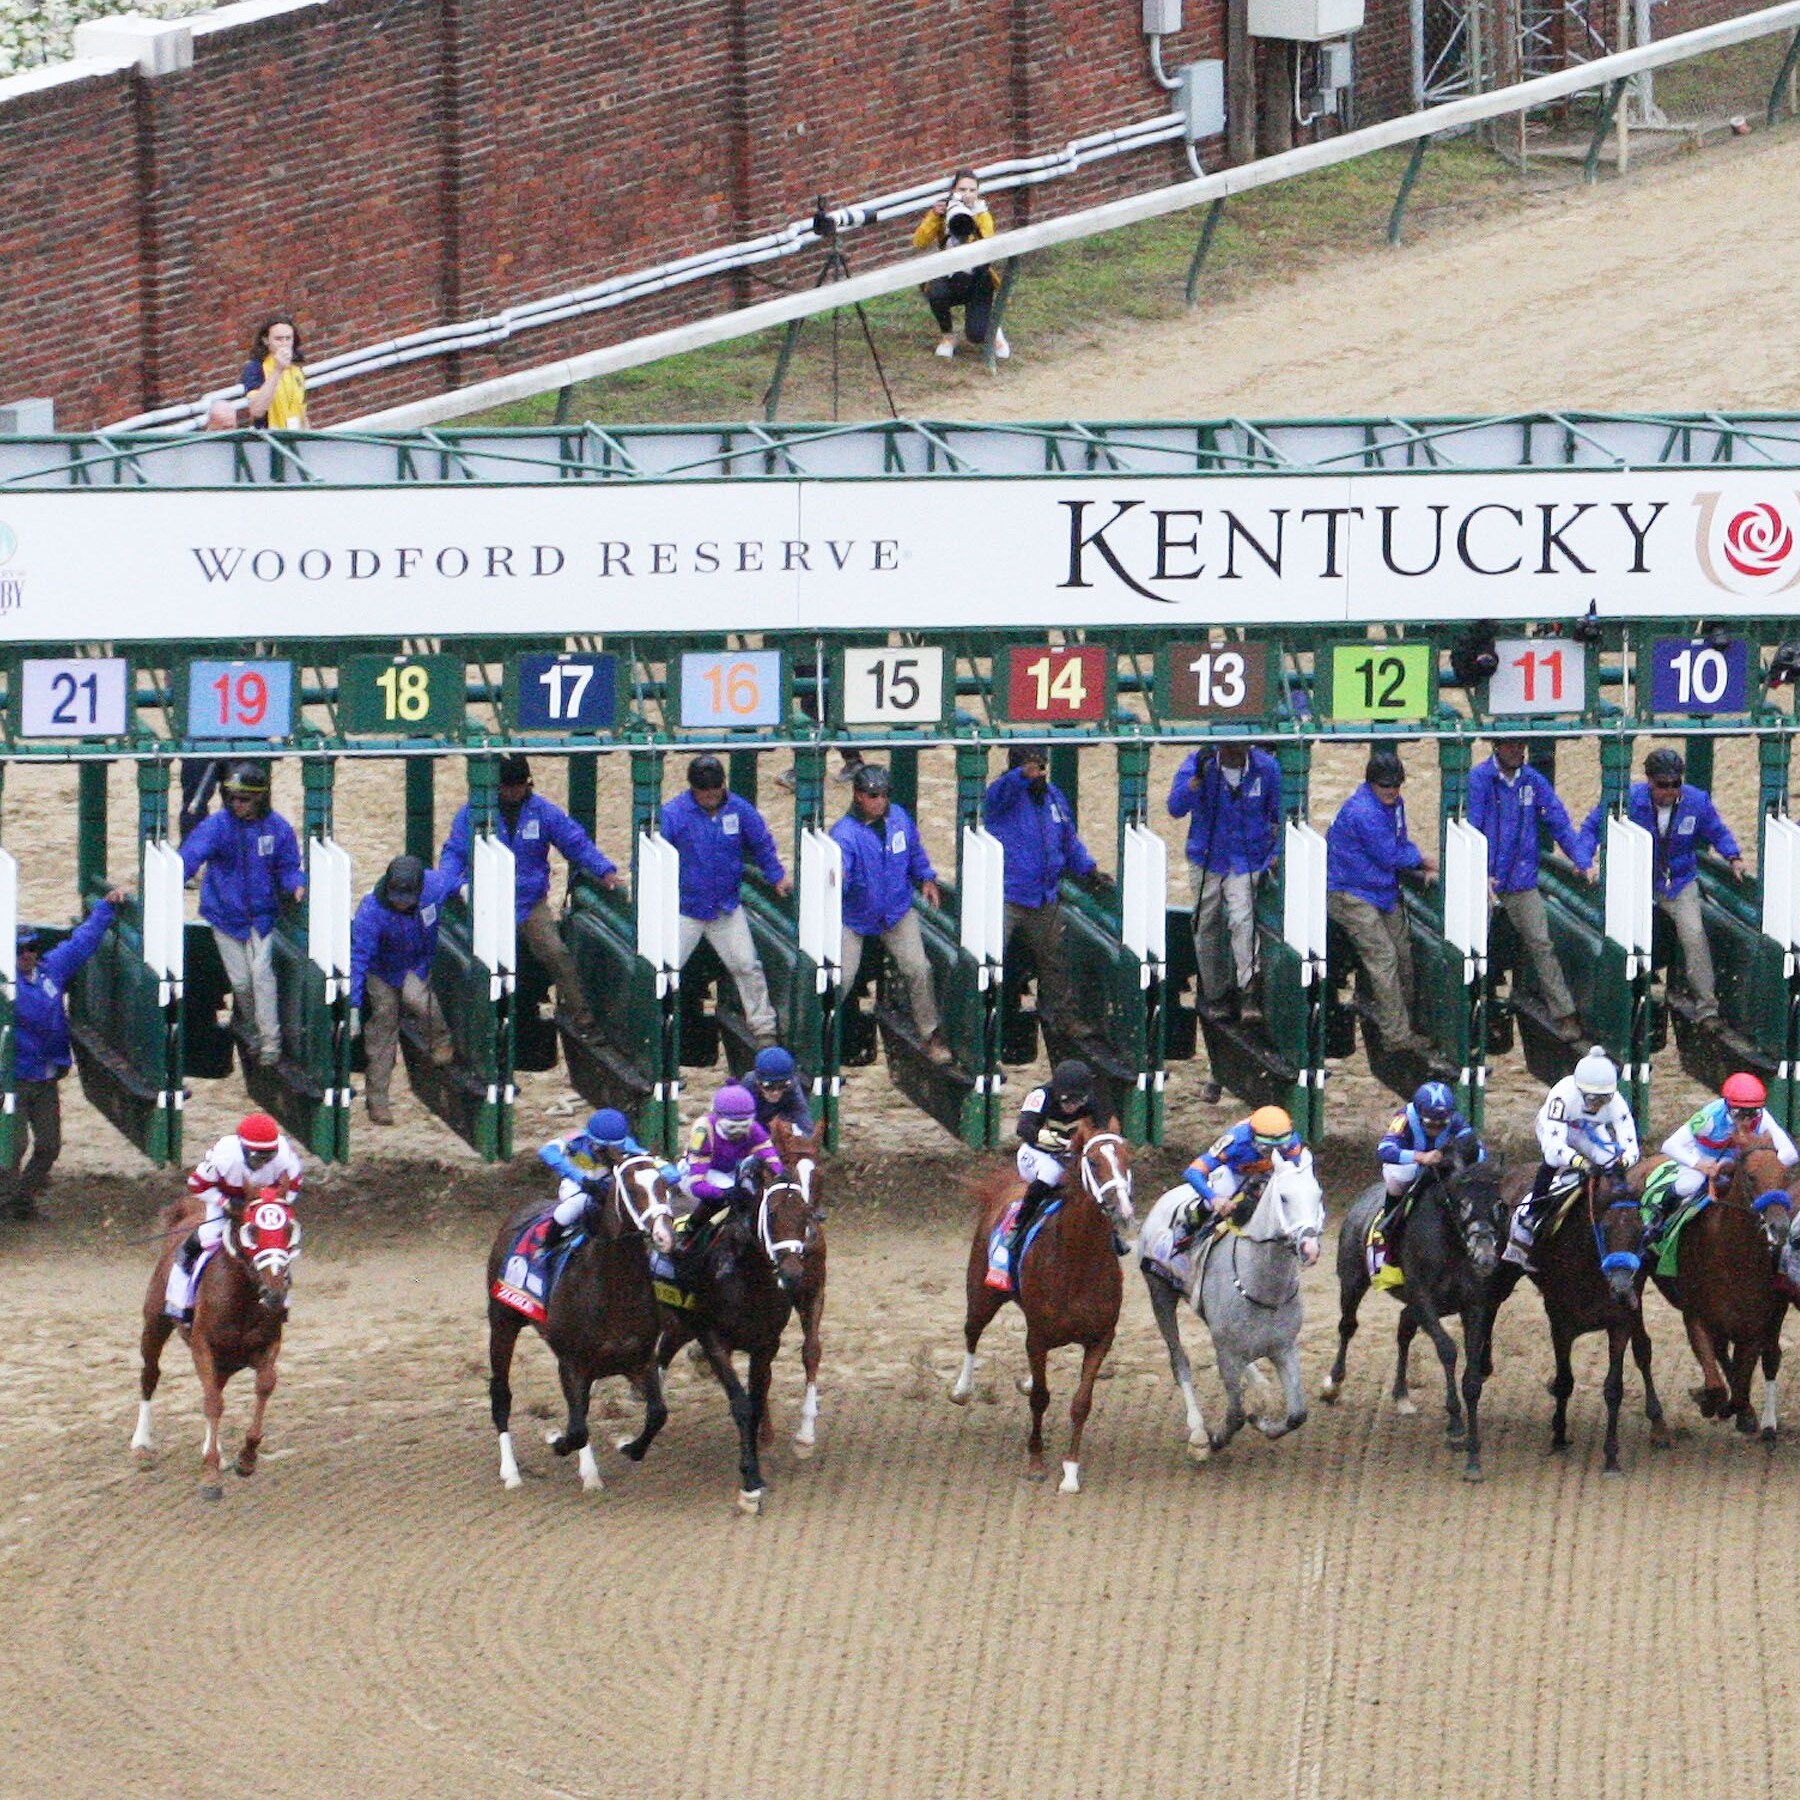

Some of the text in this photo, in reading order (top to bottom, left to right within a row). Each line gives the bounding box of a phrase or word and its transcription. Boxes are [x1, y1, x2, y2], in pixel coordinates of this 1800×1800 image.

[191, 540, 899, 583] WOODFORD RESERVE
[1056, 500, 1670, 604] KENTUCKY
[51, 672, 98, 724] 21
[214, 672, 268, 726] 19
[376, 665, 430, 722] 18
[539, 664, 595, 719] 17
[703, 661, 760, 715] 16
[866, 658, 920, 711] 15
[1027, 657, 1087, 711] 14
[1189, 651, 1246, 708] 13
[1354, 656, 1407, 709] 12
[1512, 650, 1562, 702] 11
[1668, 647, 1729, 704] 10
